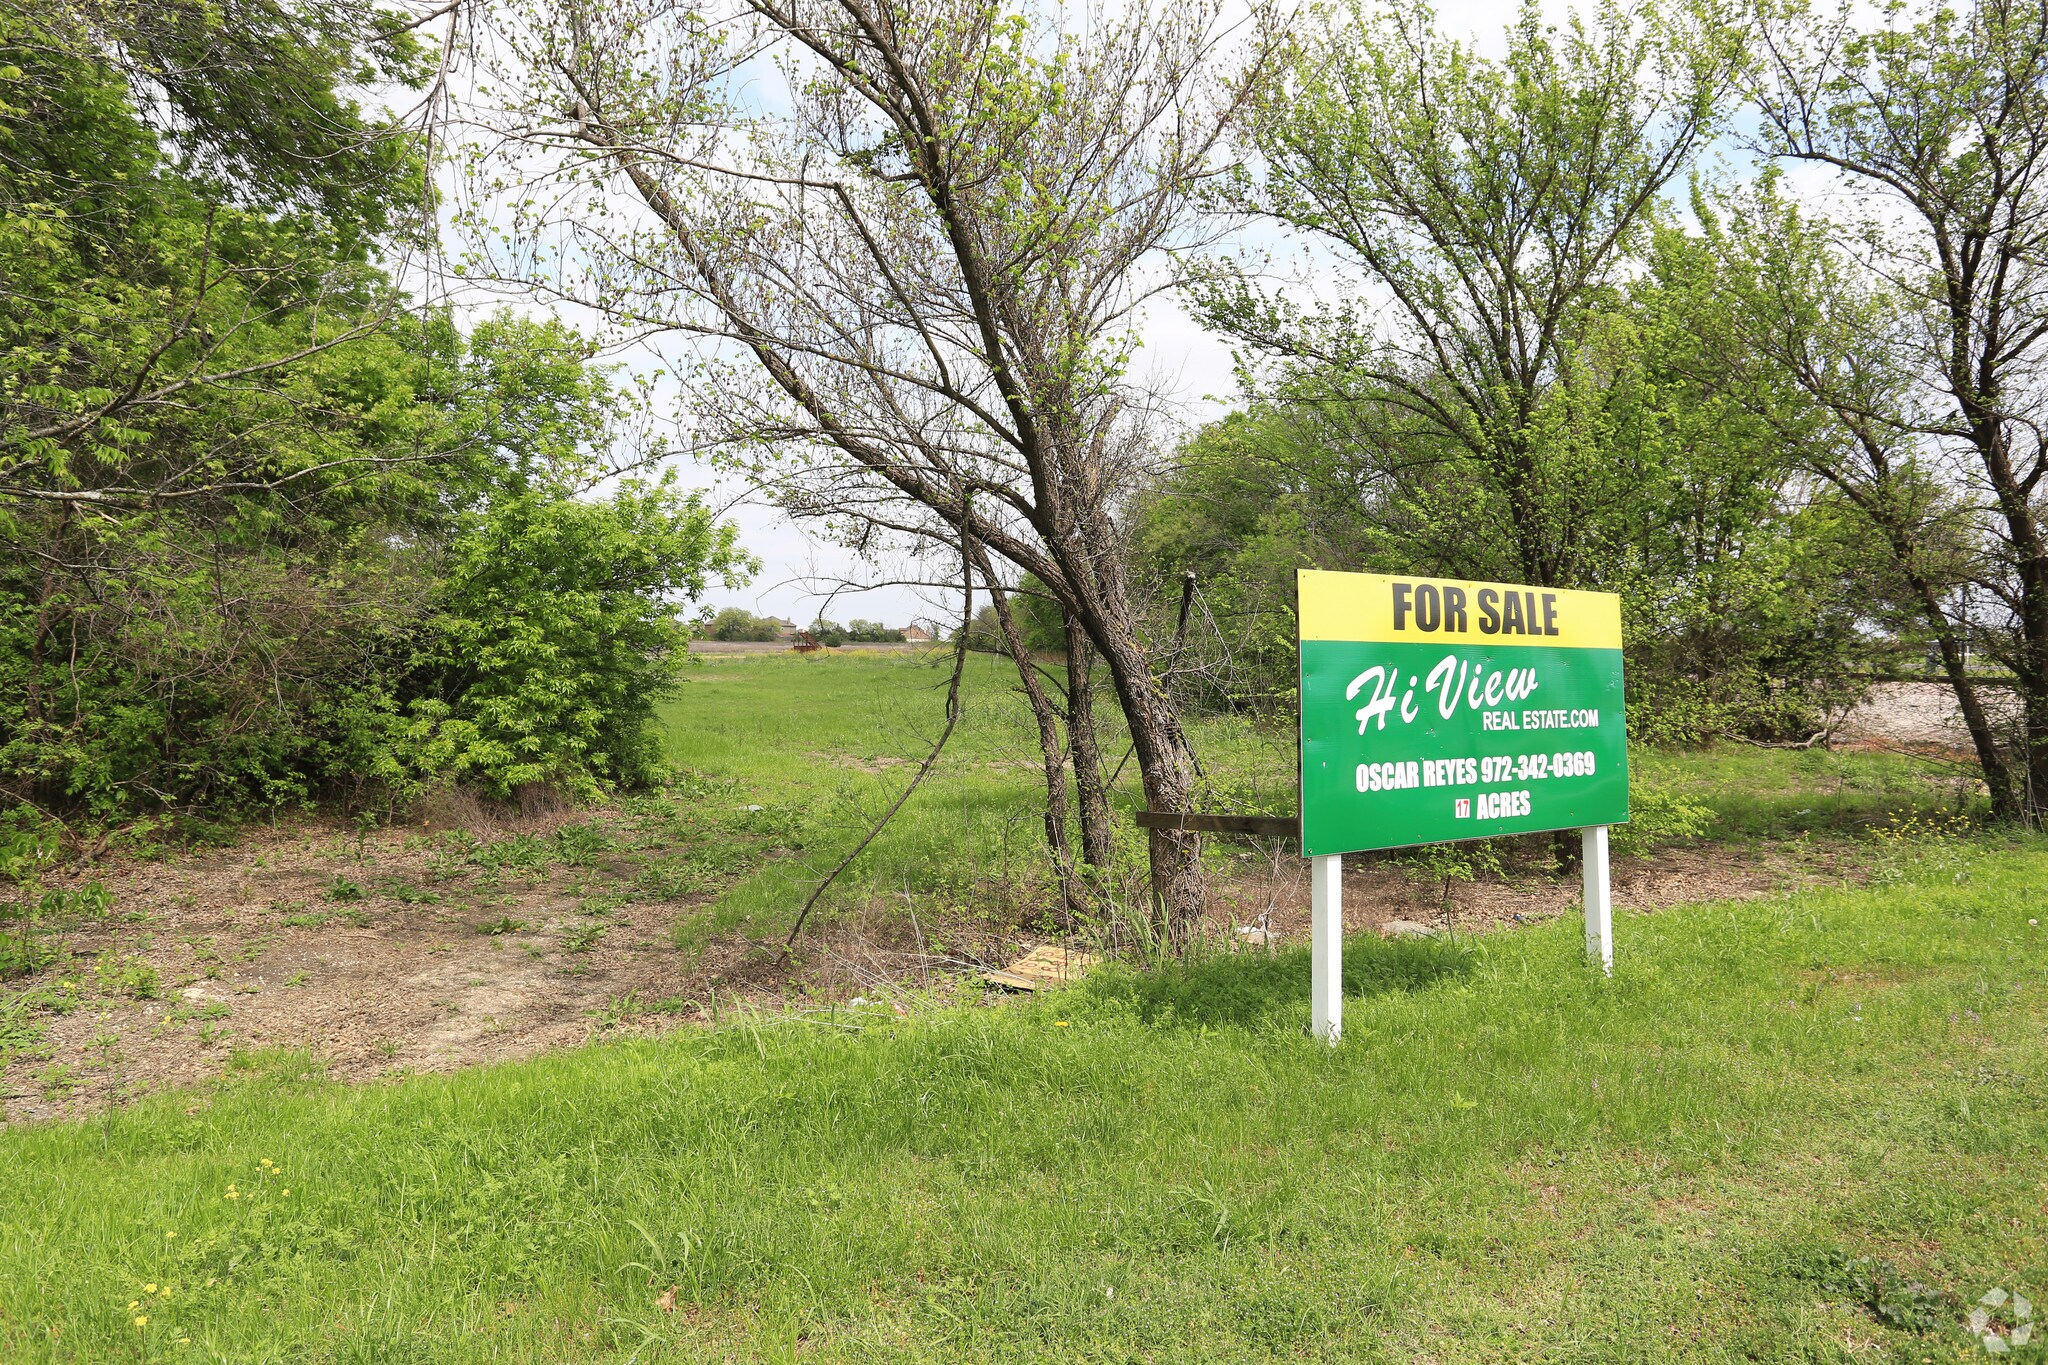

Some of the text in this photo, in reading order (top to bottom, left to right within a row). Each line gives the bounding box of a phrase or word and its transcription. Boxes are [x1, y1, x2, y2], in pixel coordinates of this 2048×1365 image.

[1392, 583, 1559, 636] FOR SALE
[1345, 654, 1538, 736] Hi View
[1483, 709, 1599, 731] REAL ESTATE.COM
[1355, 751, 1596, 792] OSCAR REYES 972-342-0369
[1457, 790, 1531, 820] 17 ACRES
